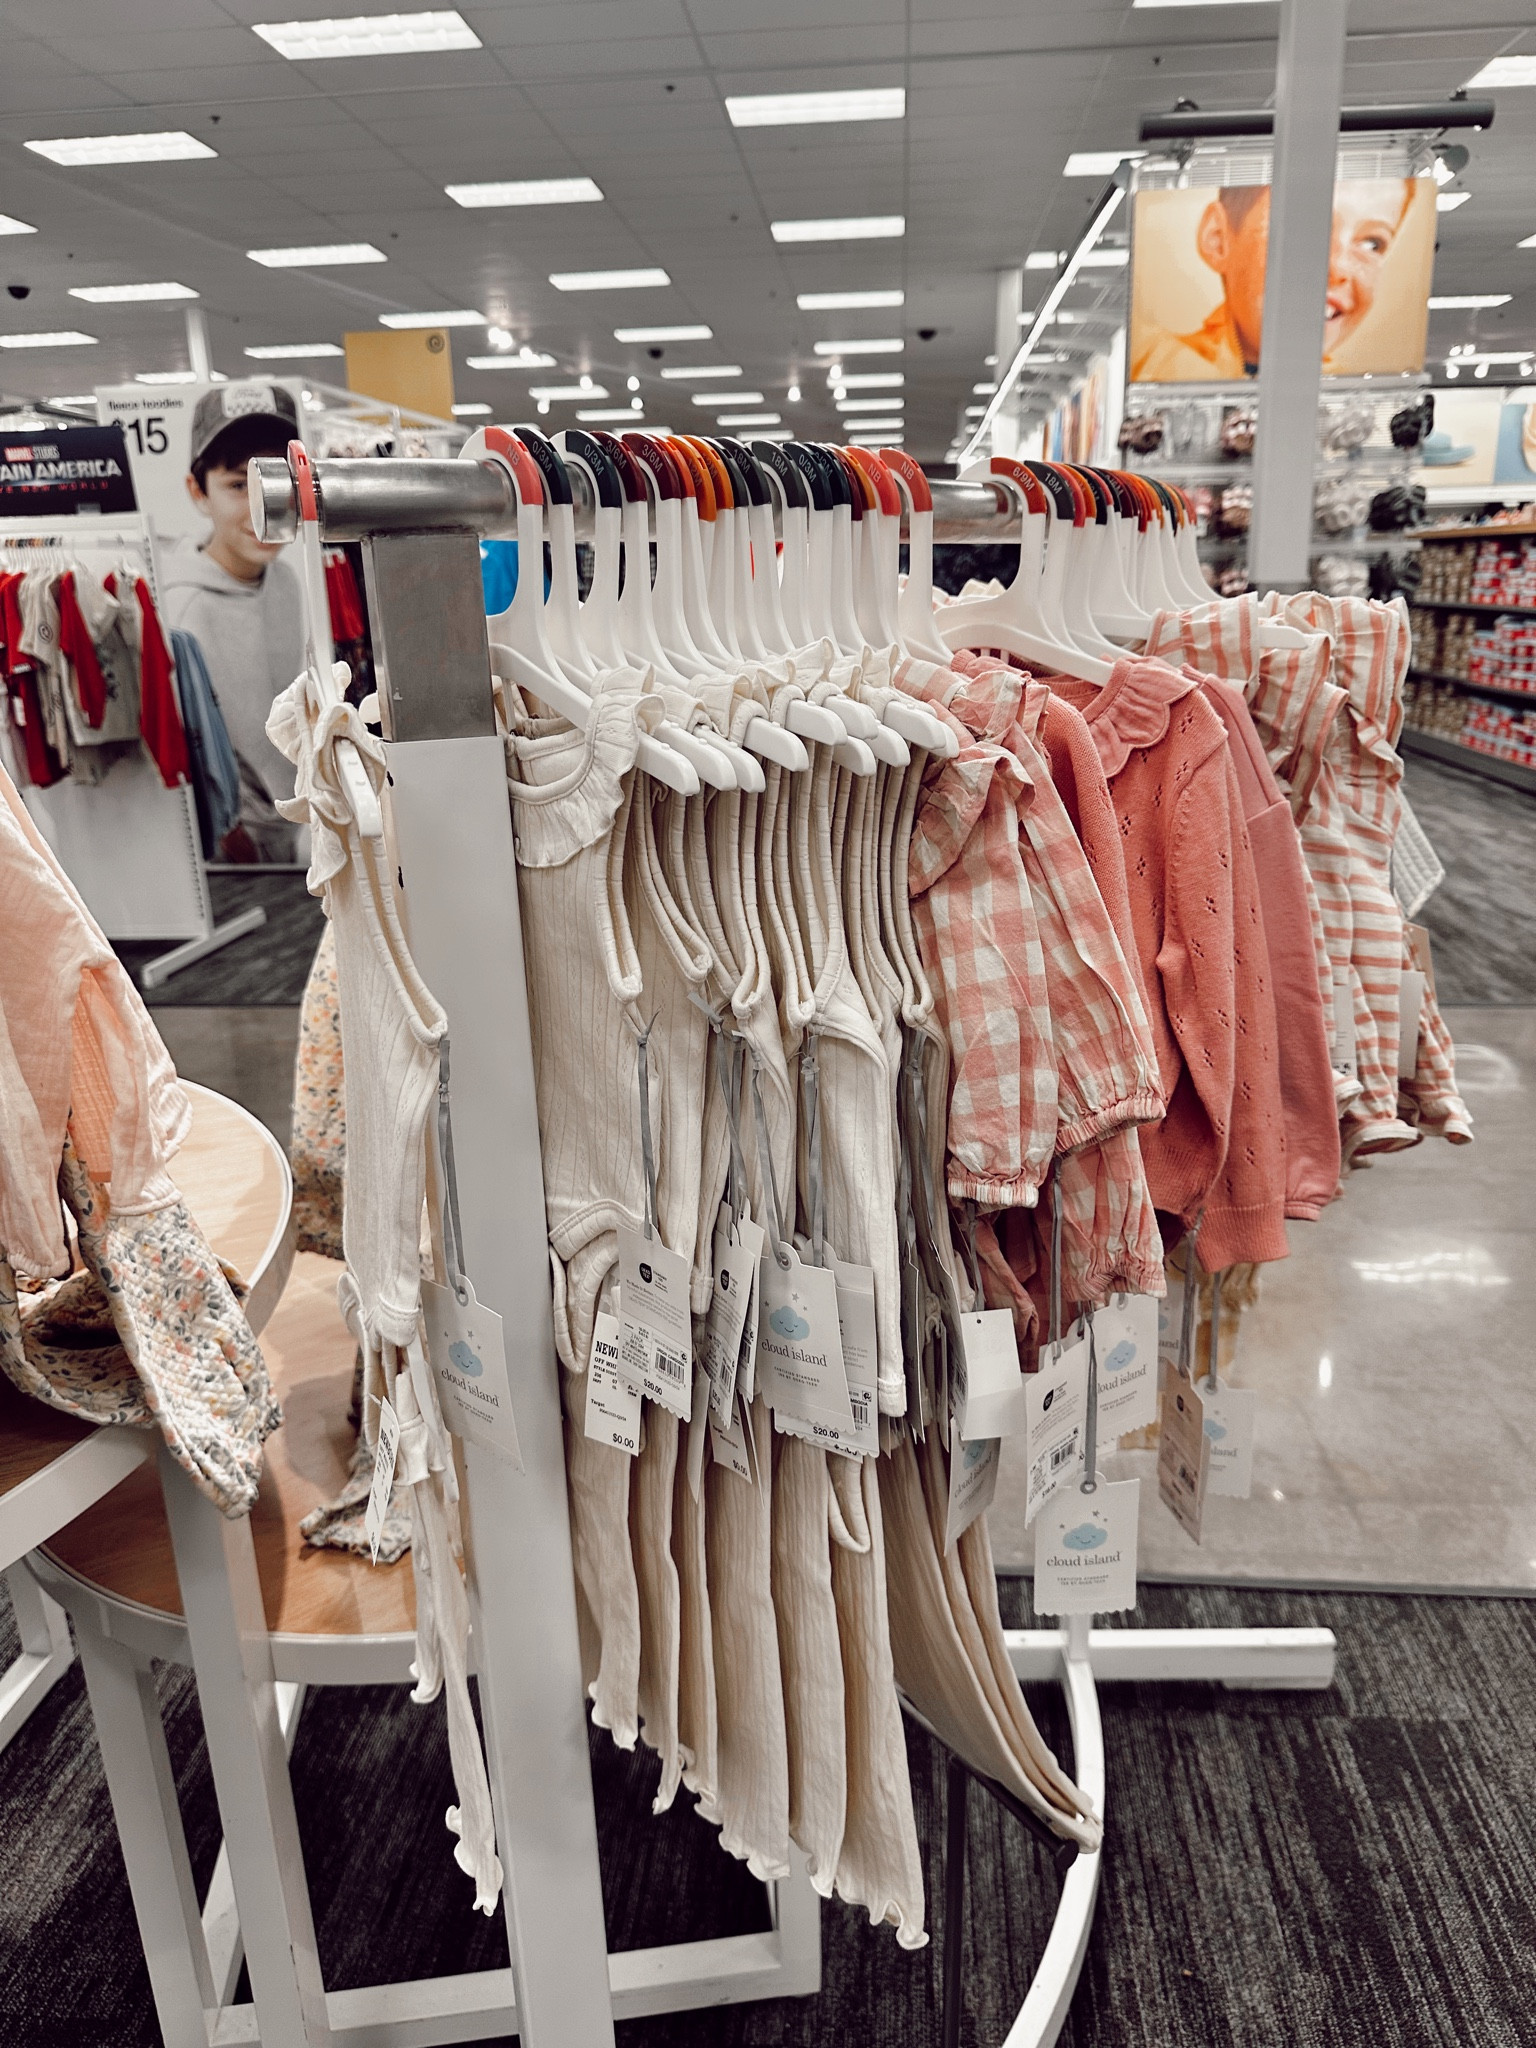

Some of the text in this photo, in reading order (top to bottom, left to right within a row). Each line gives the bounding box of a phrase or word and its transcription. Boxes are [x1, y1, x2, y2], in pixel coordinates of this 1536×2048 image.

[143, 398, 184, 410] hoodies
[507, 444, 520, 466] NB
[532, 441, 553, 473] 0/3M
[584, 444, 605, 476] 0/3M
[606, 440, 627, 469] 3/6M
[641, 444, 664, 473] 3/6M
[771, 451, 789, 477] 18M
[35, 458, 122, 481] AMERICA
[799, 454, 817, 483] 0/3M
[868, 463, 881, 483] NB
[901, 461, 914, 480] NB
[1012, 466, 1036, 492] 6/9M
[1044, 472, 1063, 495] 18M
[595, 1340, 619, 1360] NEW
[761, 1338, 790, 1359] cloud
[791, 1346, 828, 1368] island
[441, 1367, 467, 1392] cloud
[467, 1381, 499, 1409] island
[643, 1378, 663, 1396] $20.00
[1097, 1364, 1147, 1394] loud island
[612, 1432, 635, 1449] $0.00
[812, 1425, 840, 1440] $20.00
[1046, 1550, 1121, 1568] cloud island
